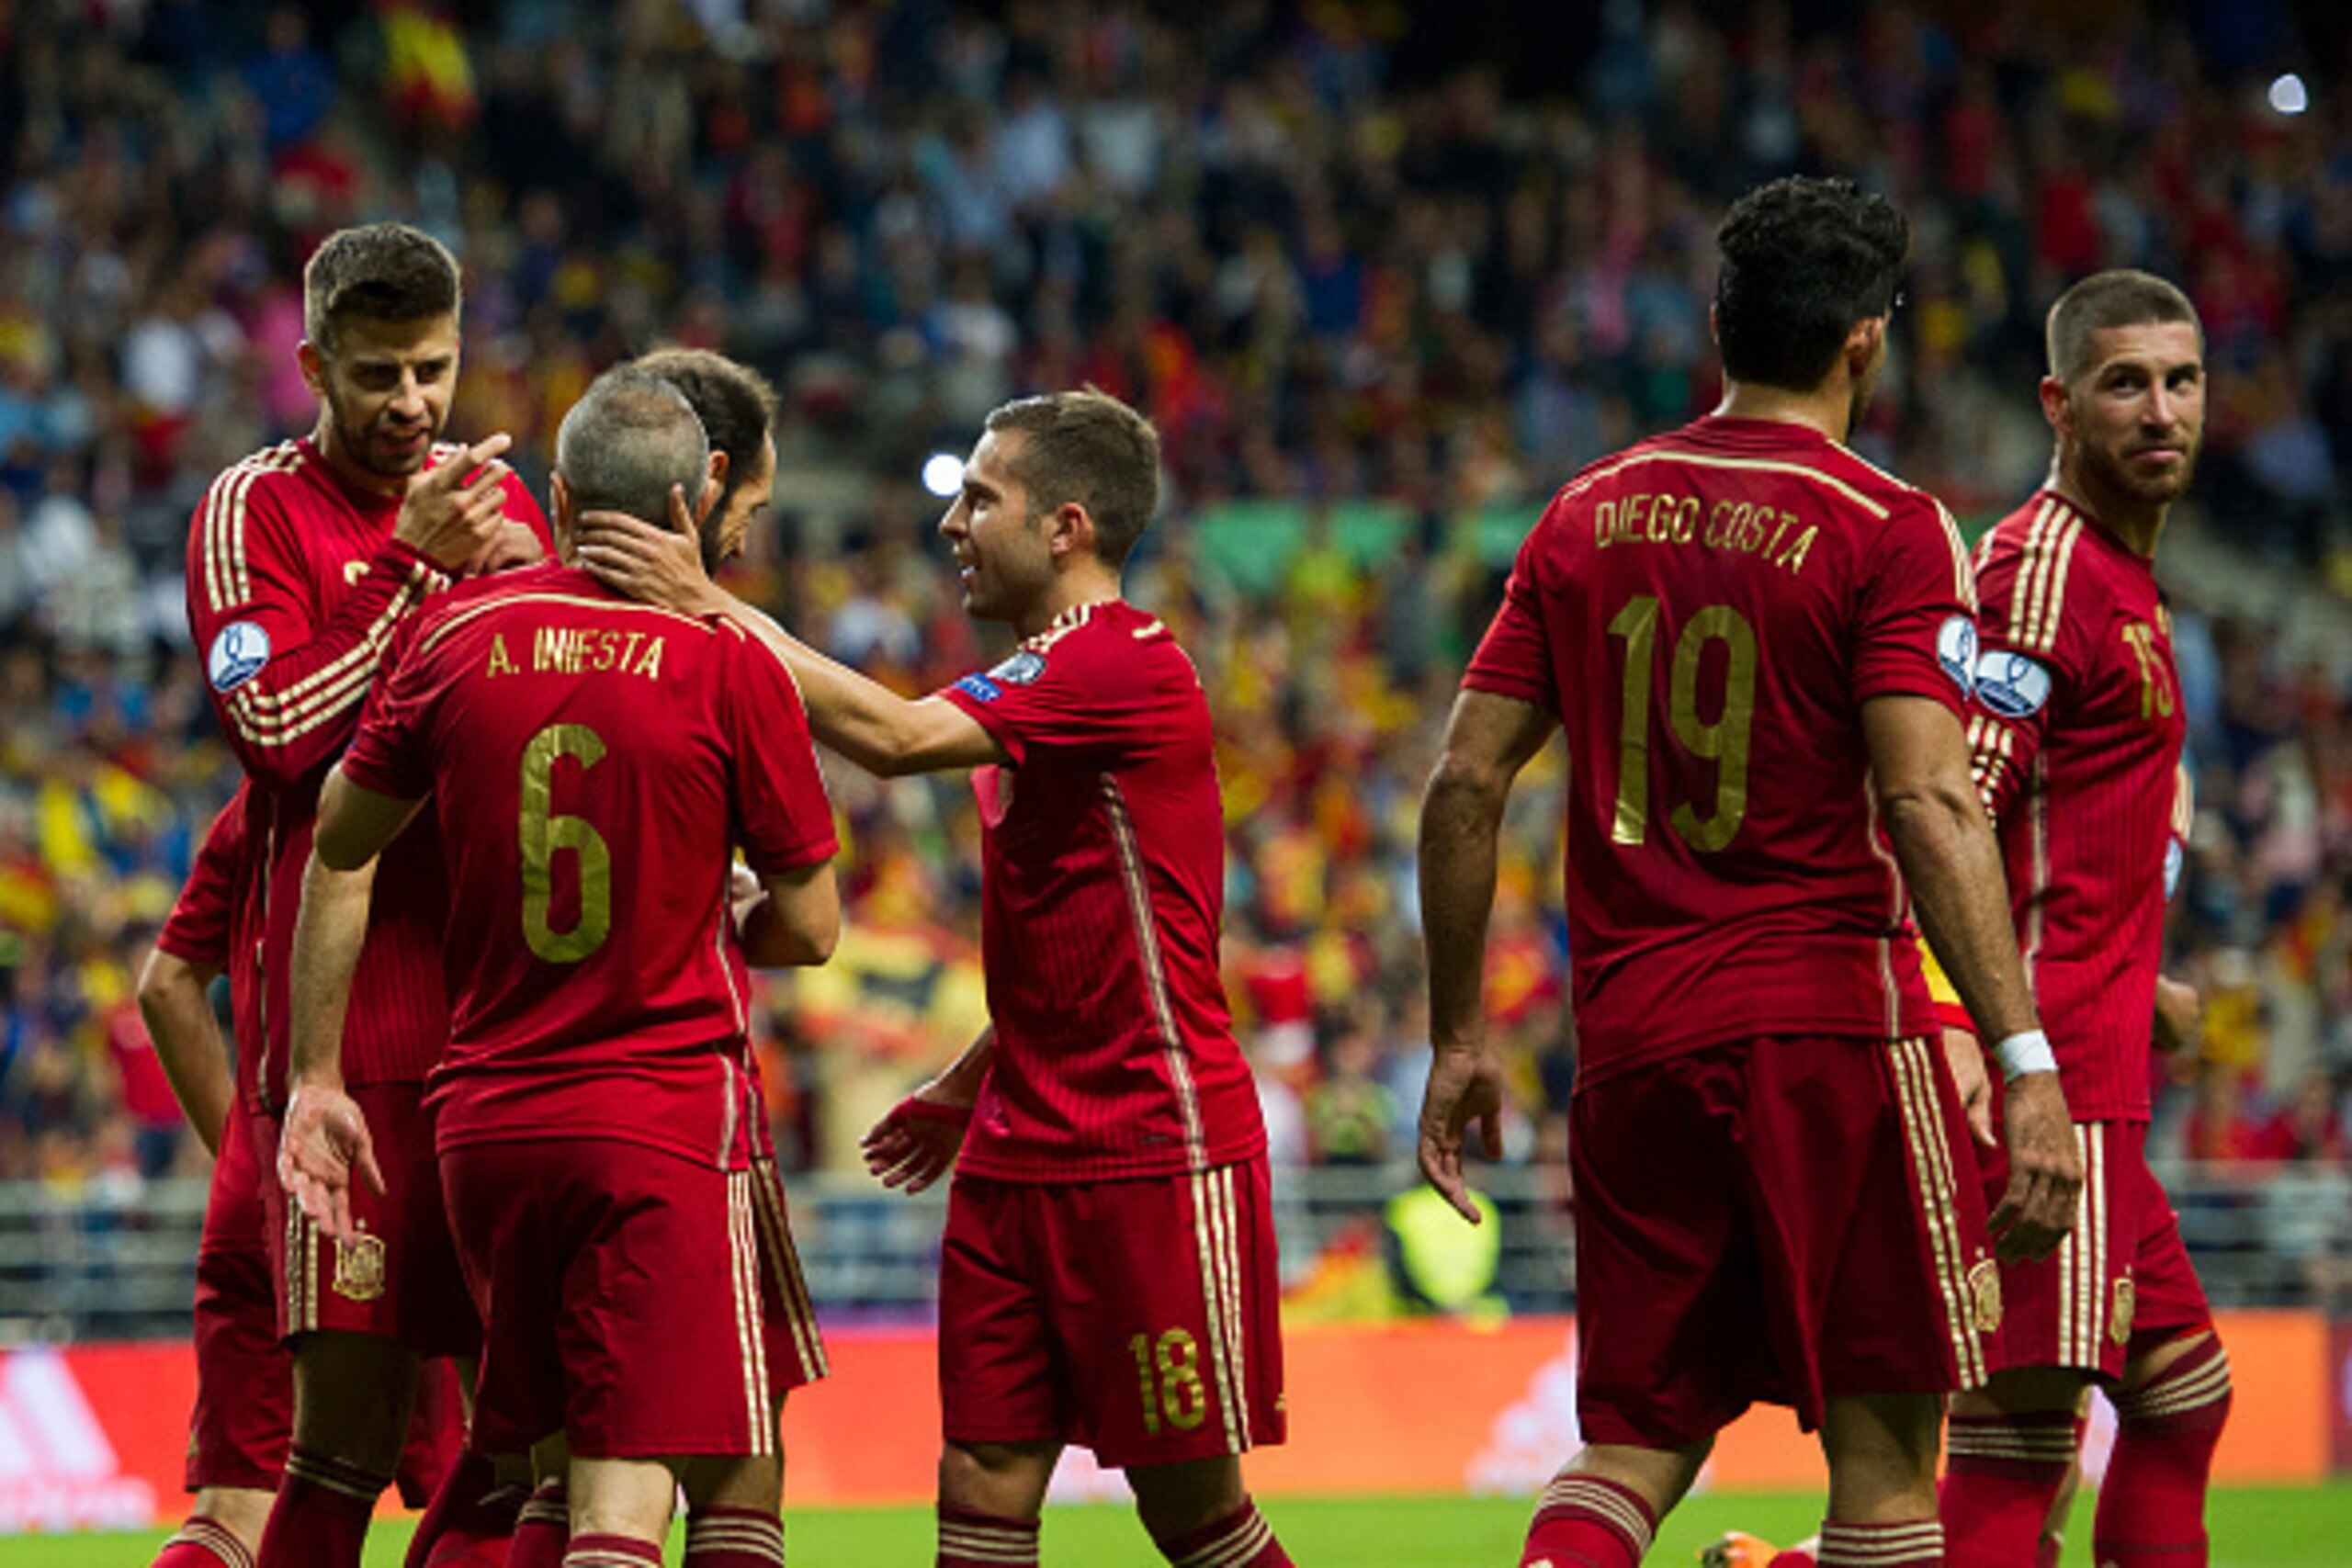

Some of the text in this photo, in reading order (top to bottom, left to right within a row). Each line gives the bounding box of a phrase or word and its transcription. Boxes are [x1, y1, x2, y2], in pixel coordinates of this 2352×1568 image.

[1595, 493, 1819, 575] DIEGO COSTA
[486, 626, 664, 681] A. INIESTA
[2121, 622, 2174, 720] 15
[1608, 594, 1758, 852] 19
[518, 722, 611, 963] 6
[1128, 1326, 1206, 1434] 18
